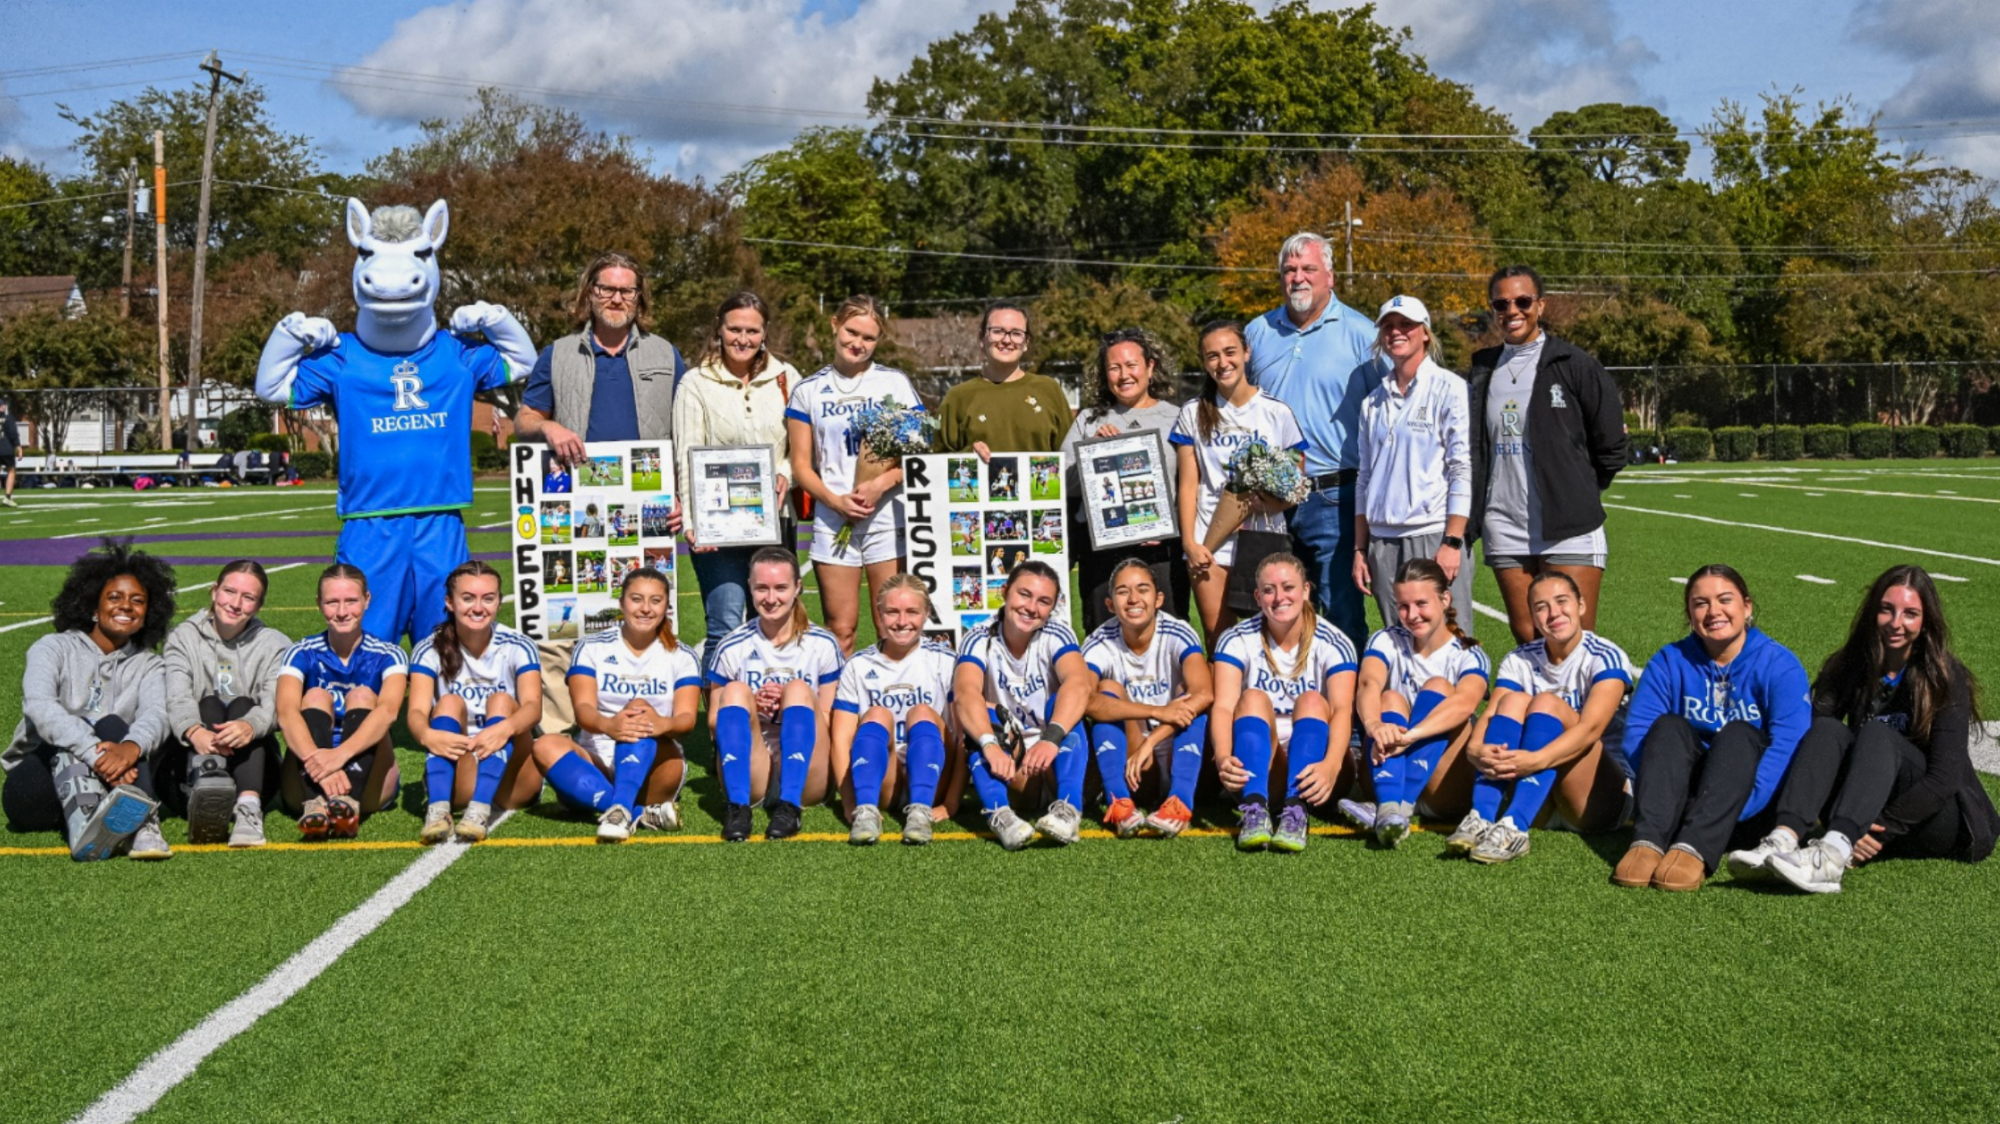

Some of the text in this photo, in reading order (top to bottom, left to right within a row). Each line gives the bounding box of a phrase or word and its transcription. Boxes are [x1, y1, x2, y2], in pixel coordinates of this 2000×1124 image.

[390, 374, 429, 412] R
[371, 412, 448, 433] REGENT
[1500, 411, 1523, 436] R
[515, 445, 542, 640] PHOEBE
[216, 673, 237, 697] R
[600, 673, 668, 702] Royals
[1254, 668, 1316, 701] Royals
[83, 686, 104, 713] R
[867, 686, 933, 714] Royals
[1683, 696, 1761, 732] Royals
